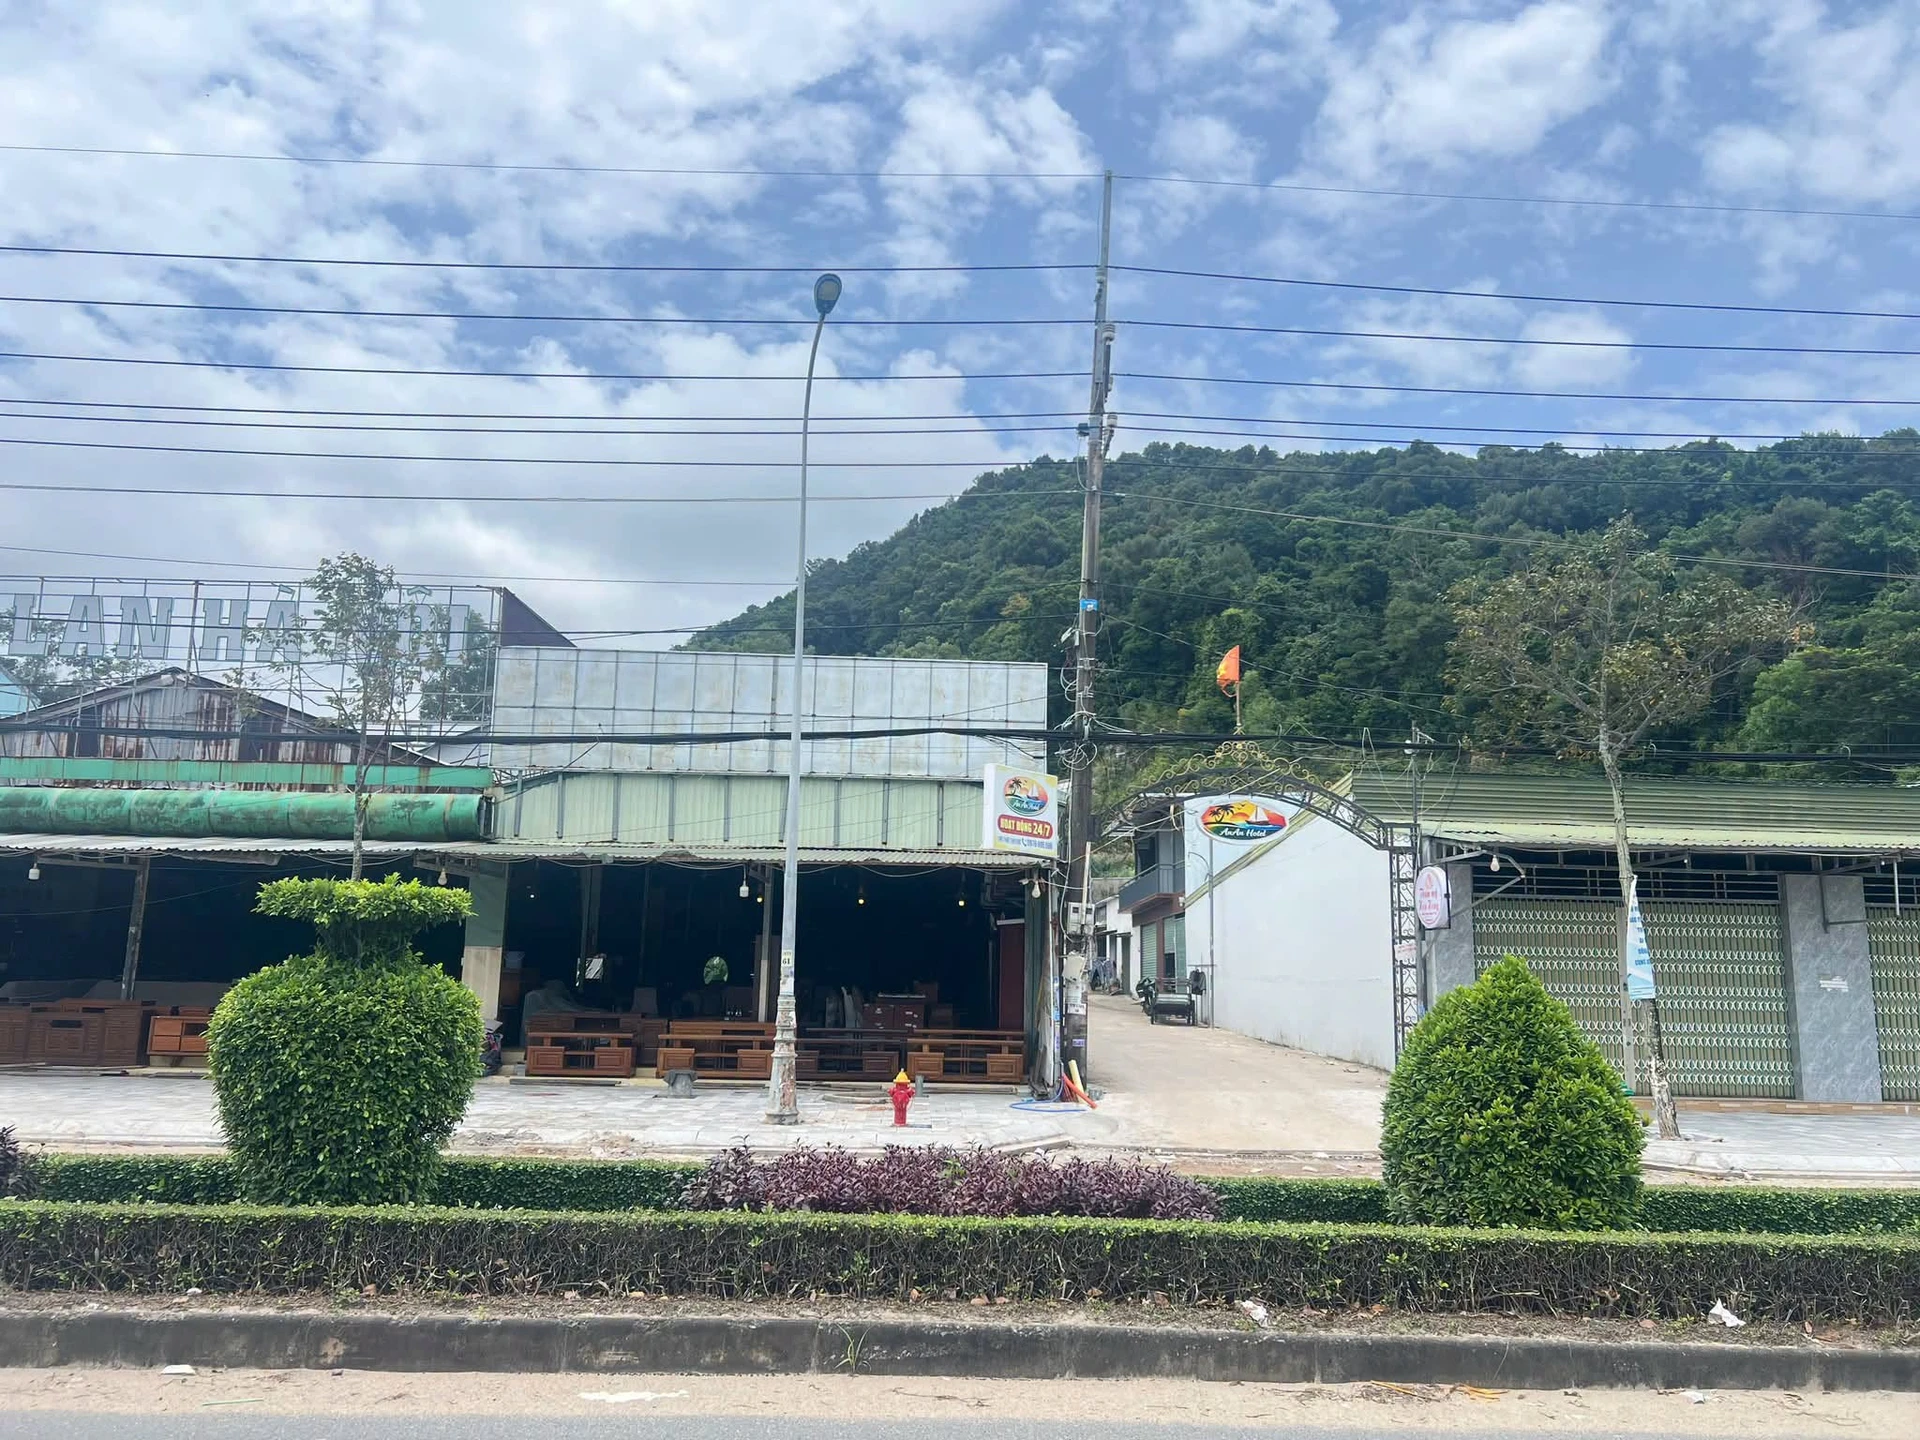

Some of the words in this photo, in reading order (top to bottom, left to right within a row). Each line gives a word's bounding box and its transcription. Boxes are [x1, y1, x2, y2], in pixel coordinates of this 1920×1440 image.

[8, 593, 174, 660] LAN
[199, 584, 301, 663] HÀ
[1033, 824, 1050, 837] 24/7
[1246, 828, 1267, 837] Hotel
